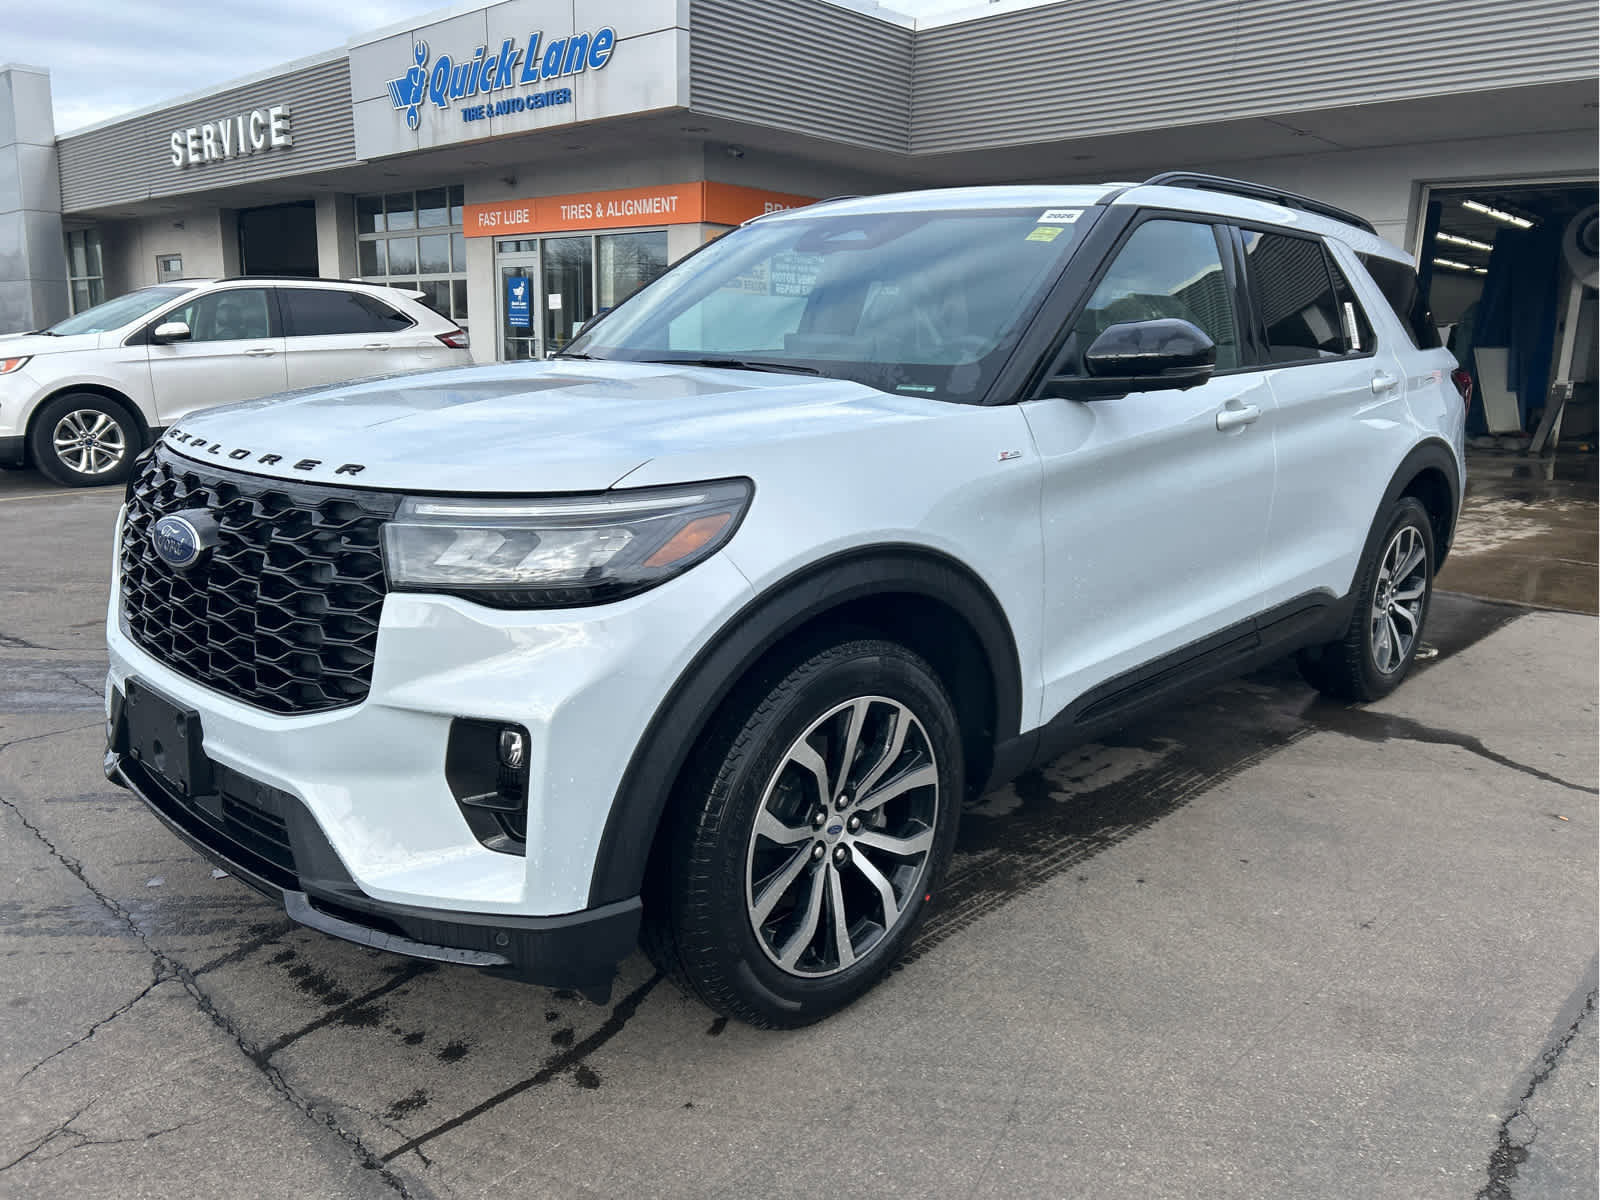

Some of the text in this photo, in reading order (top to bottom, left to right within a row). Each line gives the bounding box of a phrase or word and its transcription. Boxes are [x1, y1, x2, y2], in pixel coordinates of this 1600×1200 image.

[429, 26, 616, 110] Quick Lane
[461, 88, 572, 123] TIRE & AUTO CENTER
[171, 104, 293, 167] SERVICE
[478, 209, 529, 227] FAST LUBE
[560, 196, 678, 220] TIRES & ALIGNMENT
[169, 429, 366, 476] EXPLORER
[157, 524, 185, 556] Ford
